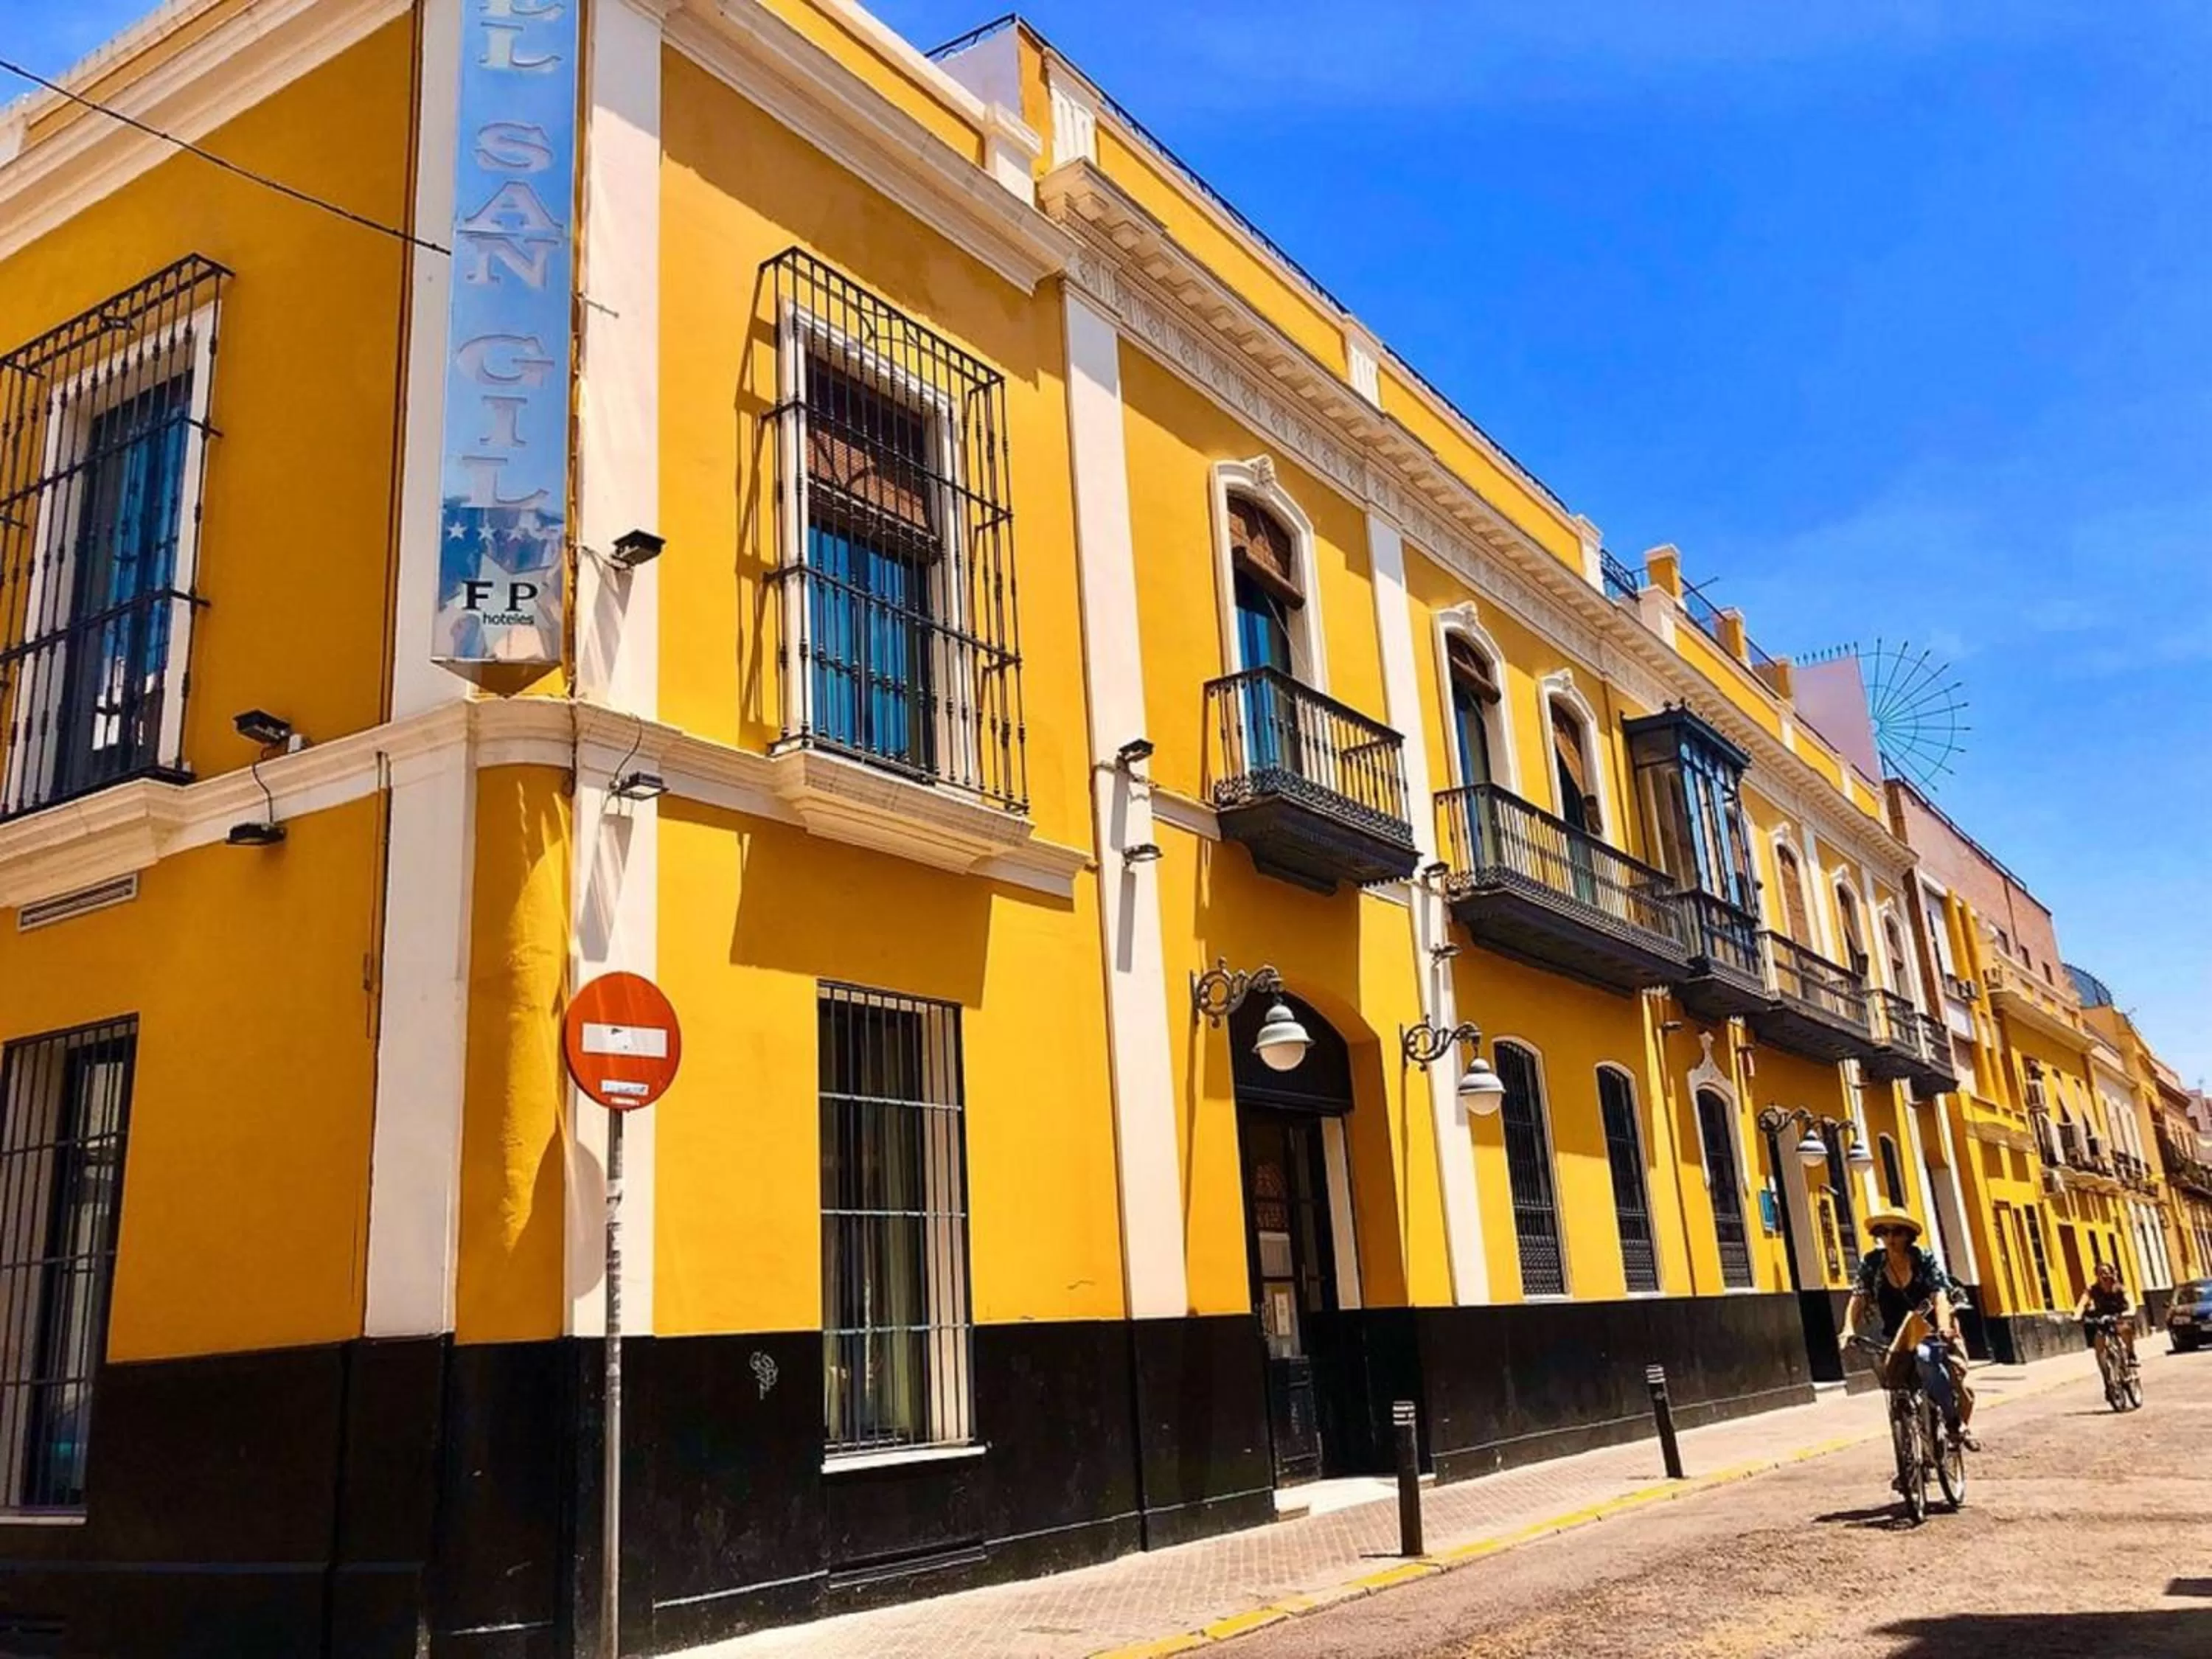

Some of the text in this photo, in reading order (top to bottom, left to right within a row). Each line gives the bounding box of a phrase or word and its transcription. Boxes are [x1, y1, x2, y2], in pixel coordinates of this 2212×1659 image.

[465, 122, 563, 290] SAN
[457, 334, 555, 509] GIL
[483, 611, 535, 625] hoteles
